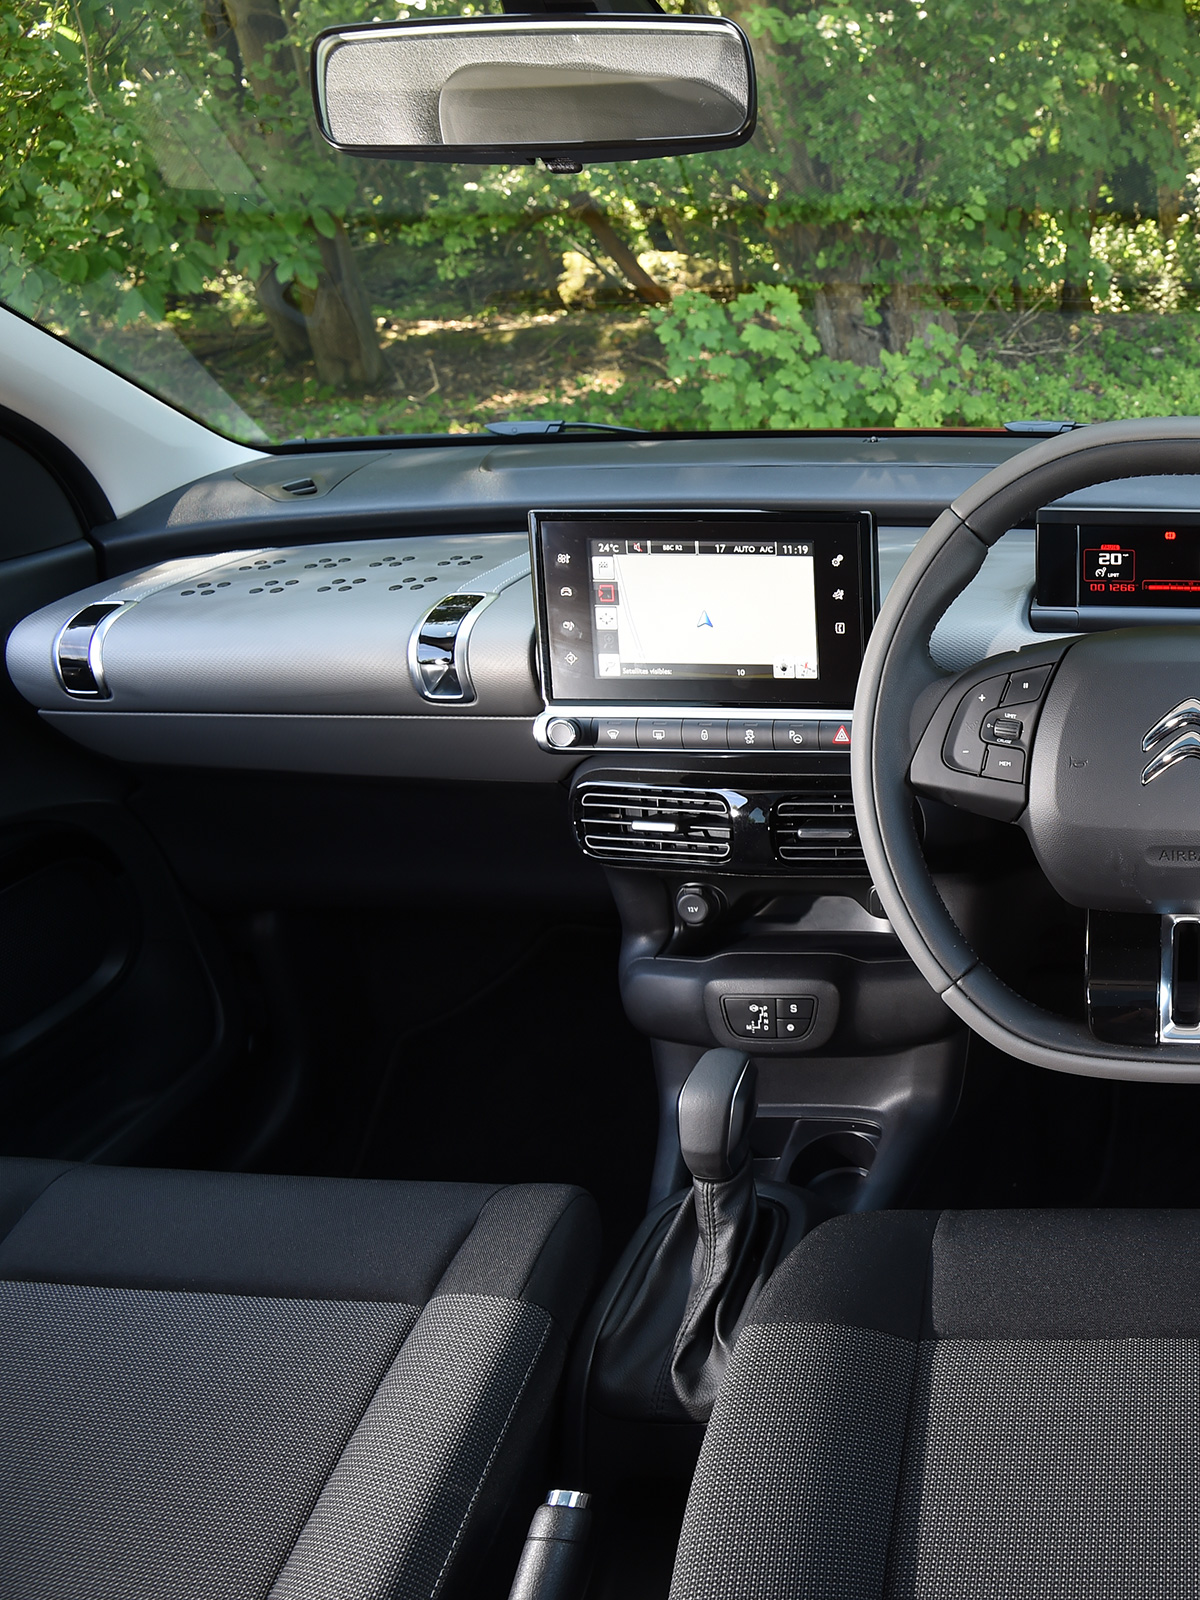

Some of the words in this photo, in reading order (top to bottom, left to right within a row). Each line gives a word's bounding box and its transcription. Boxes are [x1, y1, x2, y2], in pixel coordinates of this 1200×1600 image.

[598, 543, 619, 553] 24°C
[714, 544, 726, 553] 17
[782, 545, 809, 554] 11:19
[1098, 553, 1122, 565] 20
[736, 668, 746, 677] 10
[789, 1004, 798, 1013] S
